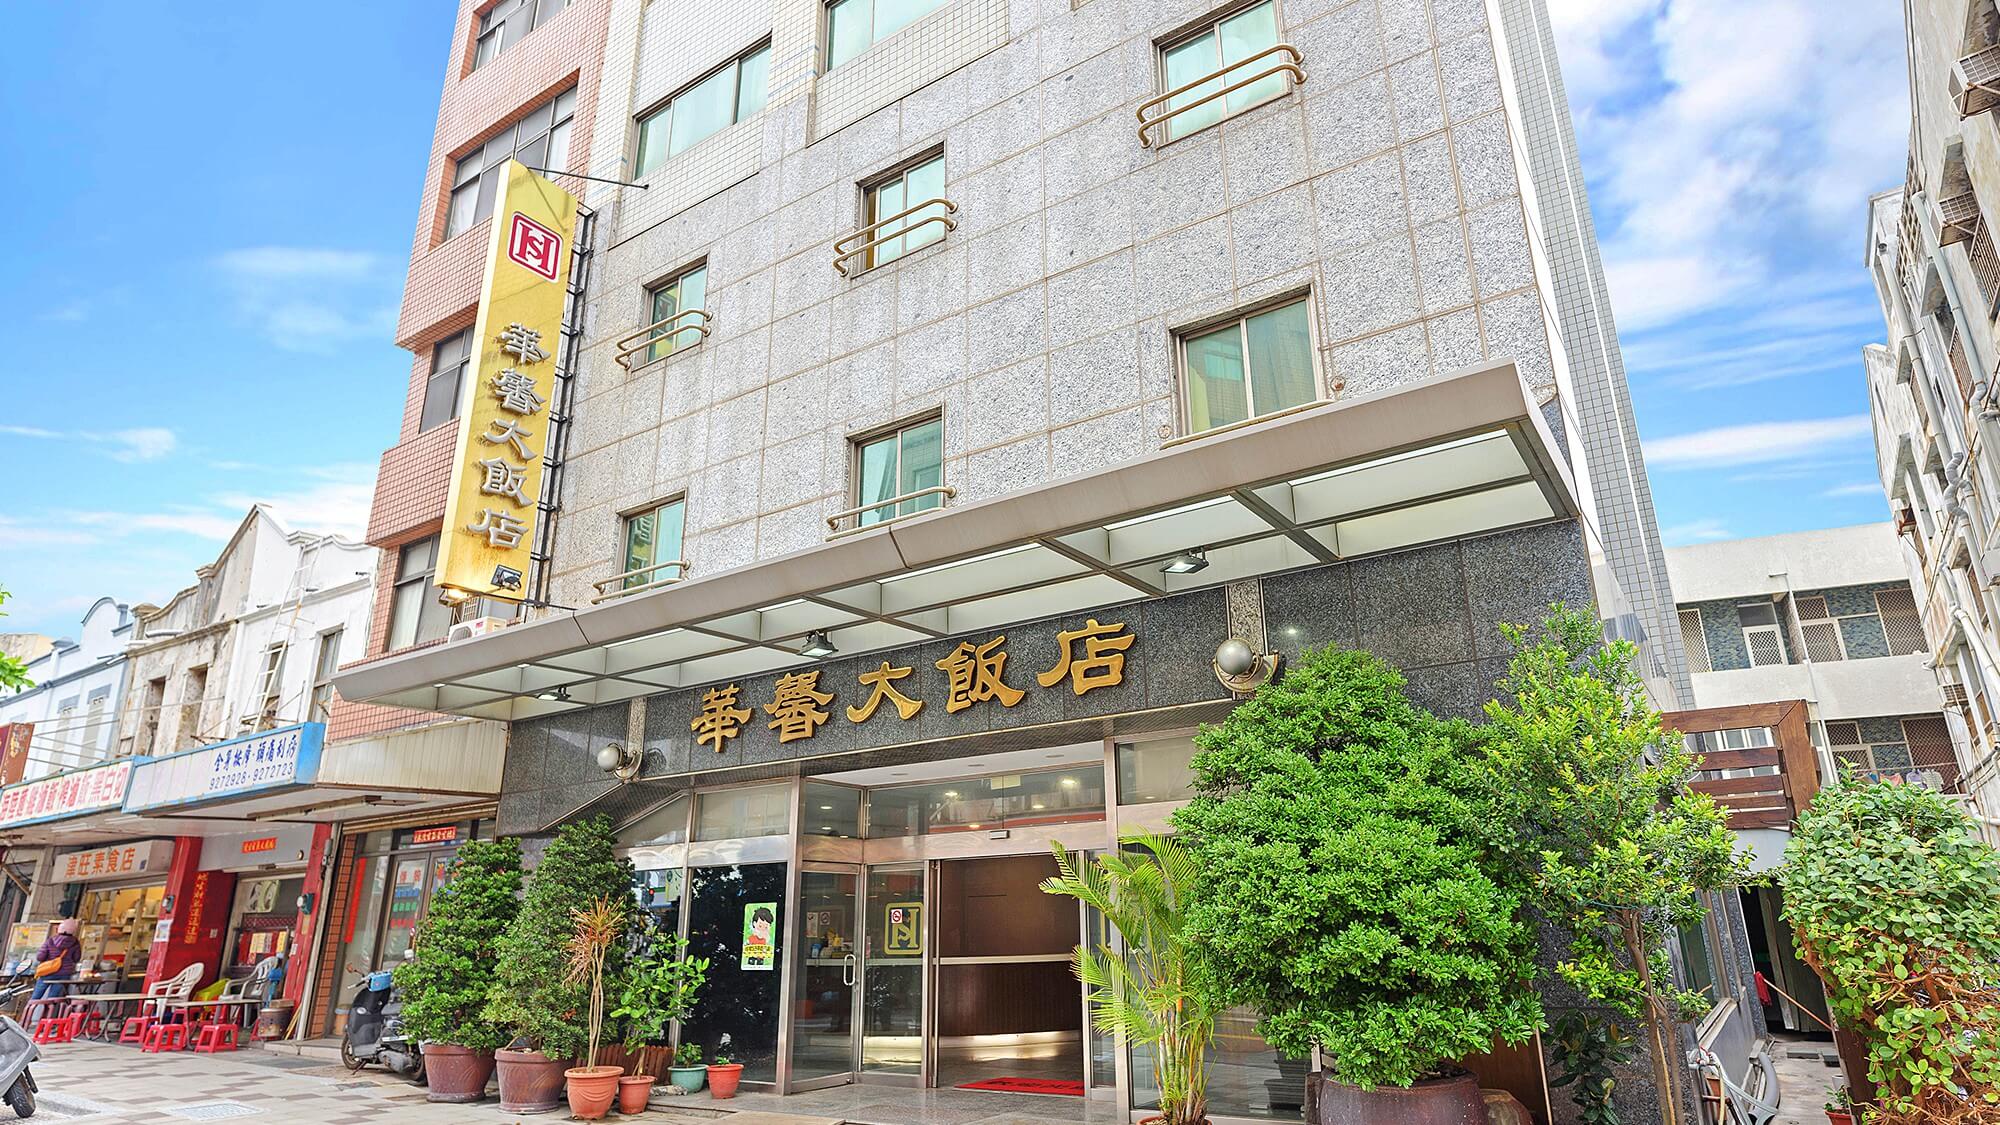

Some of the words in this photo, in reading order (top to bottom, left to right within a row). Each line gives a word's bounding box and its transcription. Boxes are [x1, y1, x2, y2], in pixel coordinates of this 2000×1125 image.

[468, 321, 551, 550] 華馨大飯店
[691, 618, 1137, 753] 華馨大飯店
